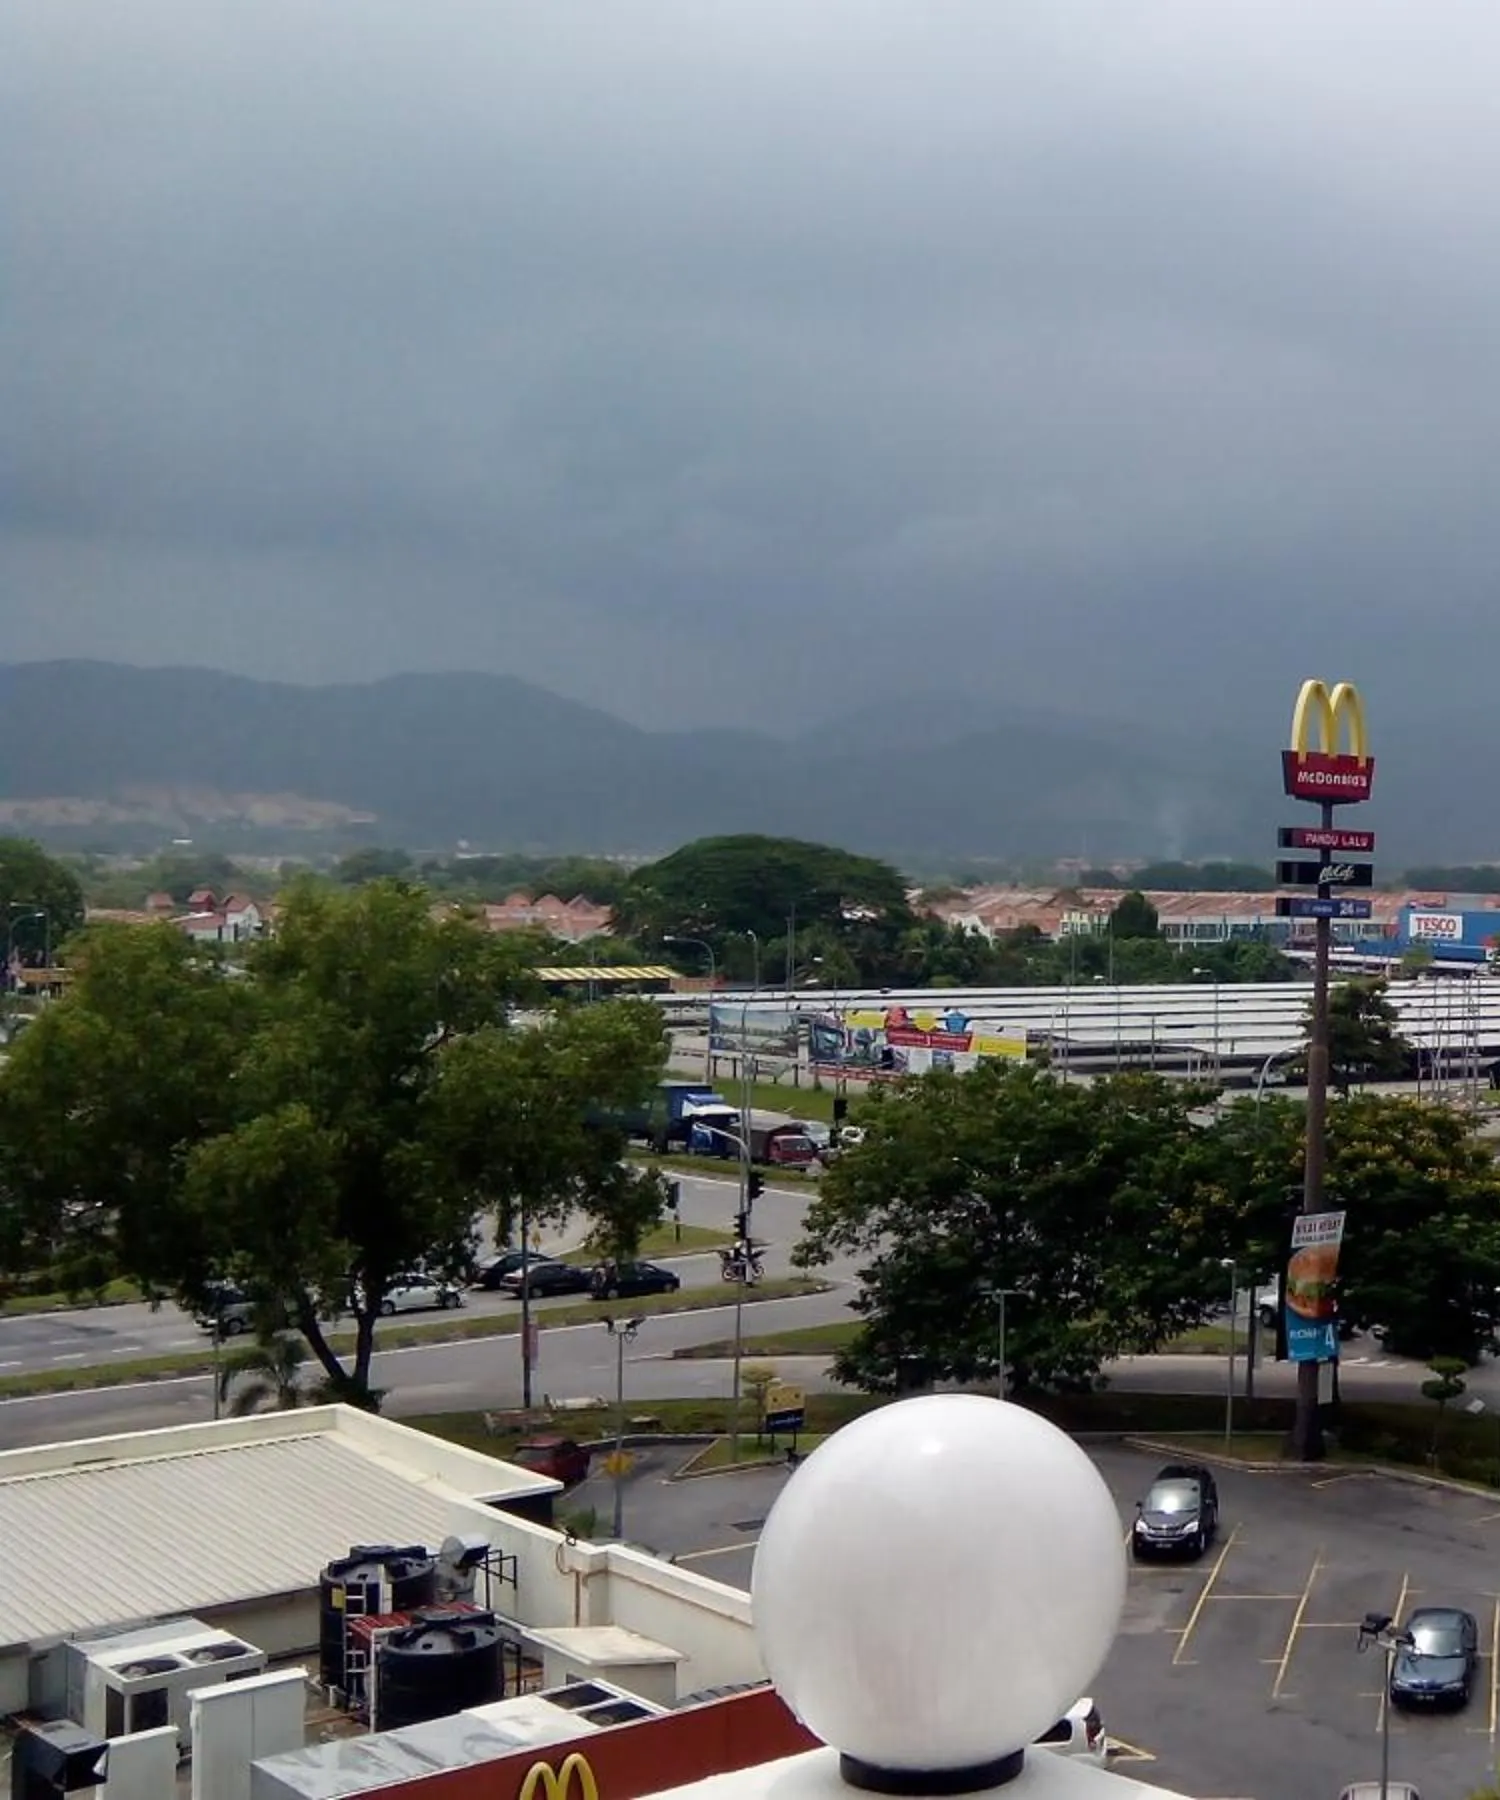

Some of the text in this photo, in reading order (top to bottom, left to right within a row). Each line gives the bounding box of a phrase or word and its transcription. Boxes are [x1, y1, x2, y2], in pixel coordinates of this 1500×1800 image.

[1297, 771, 1368, 788] McDonald's
[1304, 832, 1368, 848] PANDU LALU
[1415, 917, 1457, 932] TESCO
